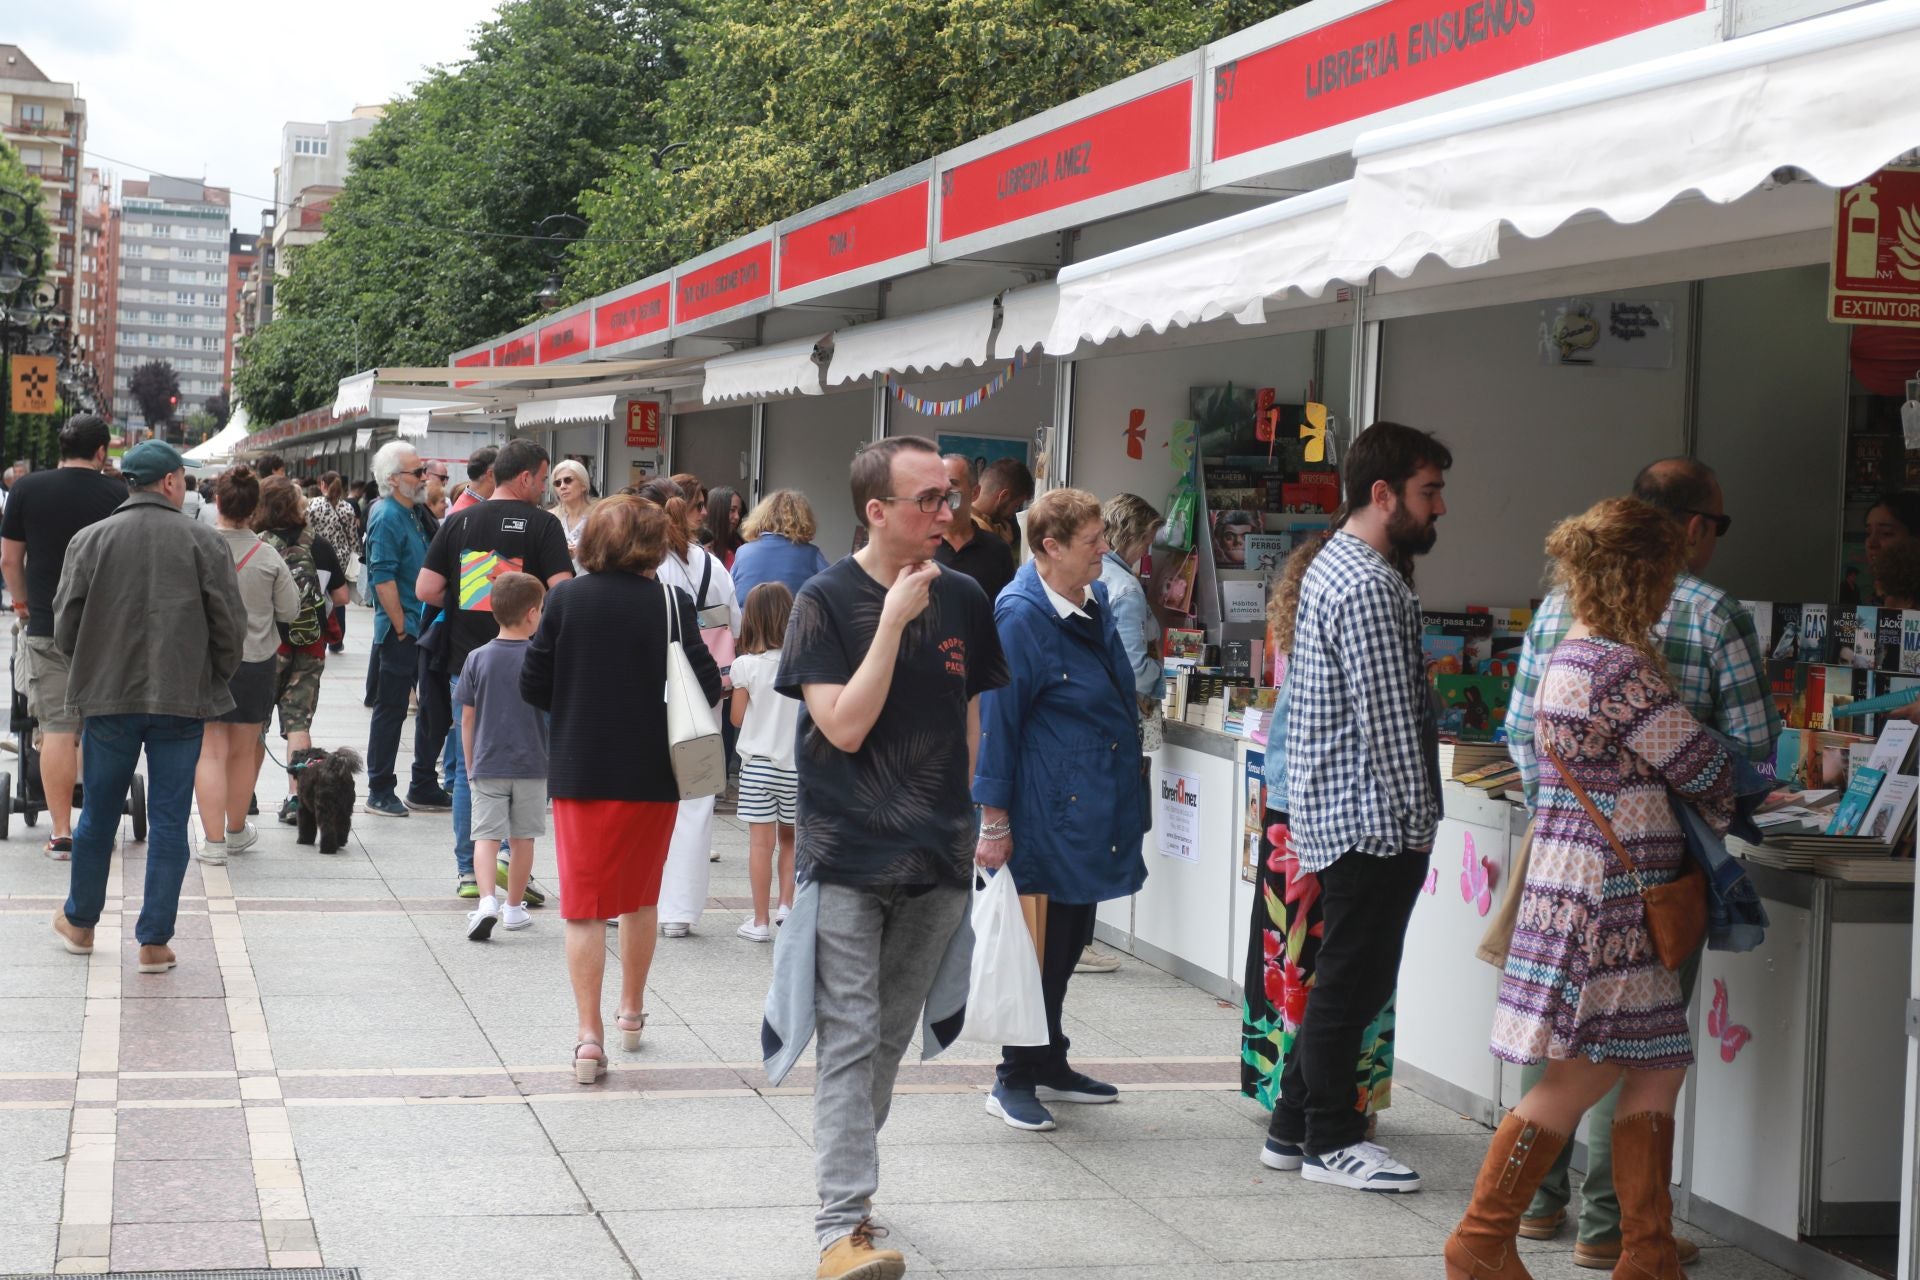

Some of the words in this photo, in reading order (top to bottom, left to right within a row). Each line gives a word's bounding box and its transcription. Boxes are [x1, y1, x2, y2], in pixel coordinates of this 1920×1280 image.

[1215, 60, 1237, 102] 57
[1305, 32, 1399, 100] LIBRERIA
[998, 156, 1049, 199] LIBRERIA
[1054, 140, 1092, 182] AMEZ
[1251, 541, 1282, 550] PERROS
[1422, 615, 1441, 625] Qué
[1443, 618, 1464, 627] pasa
